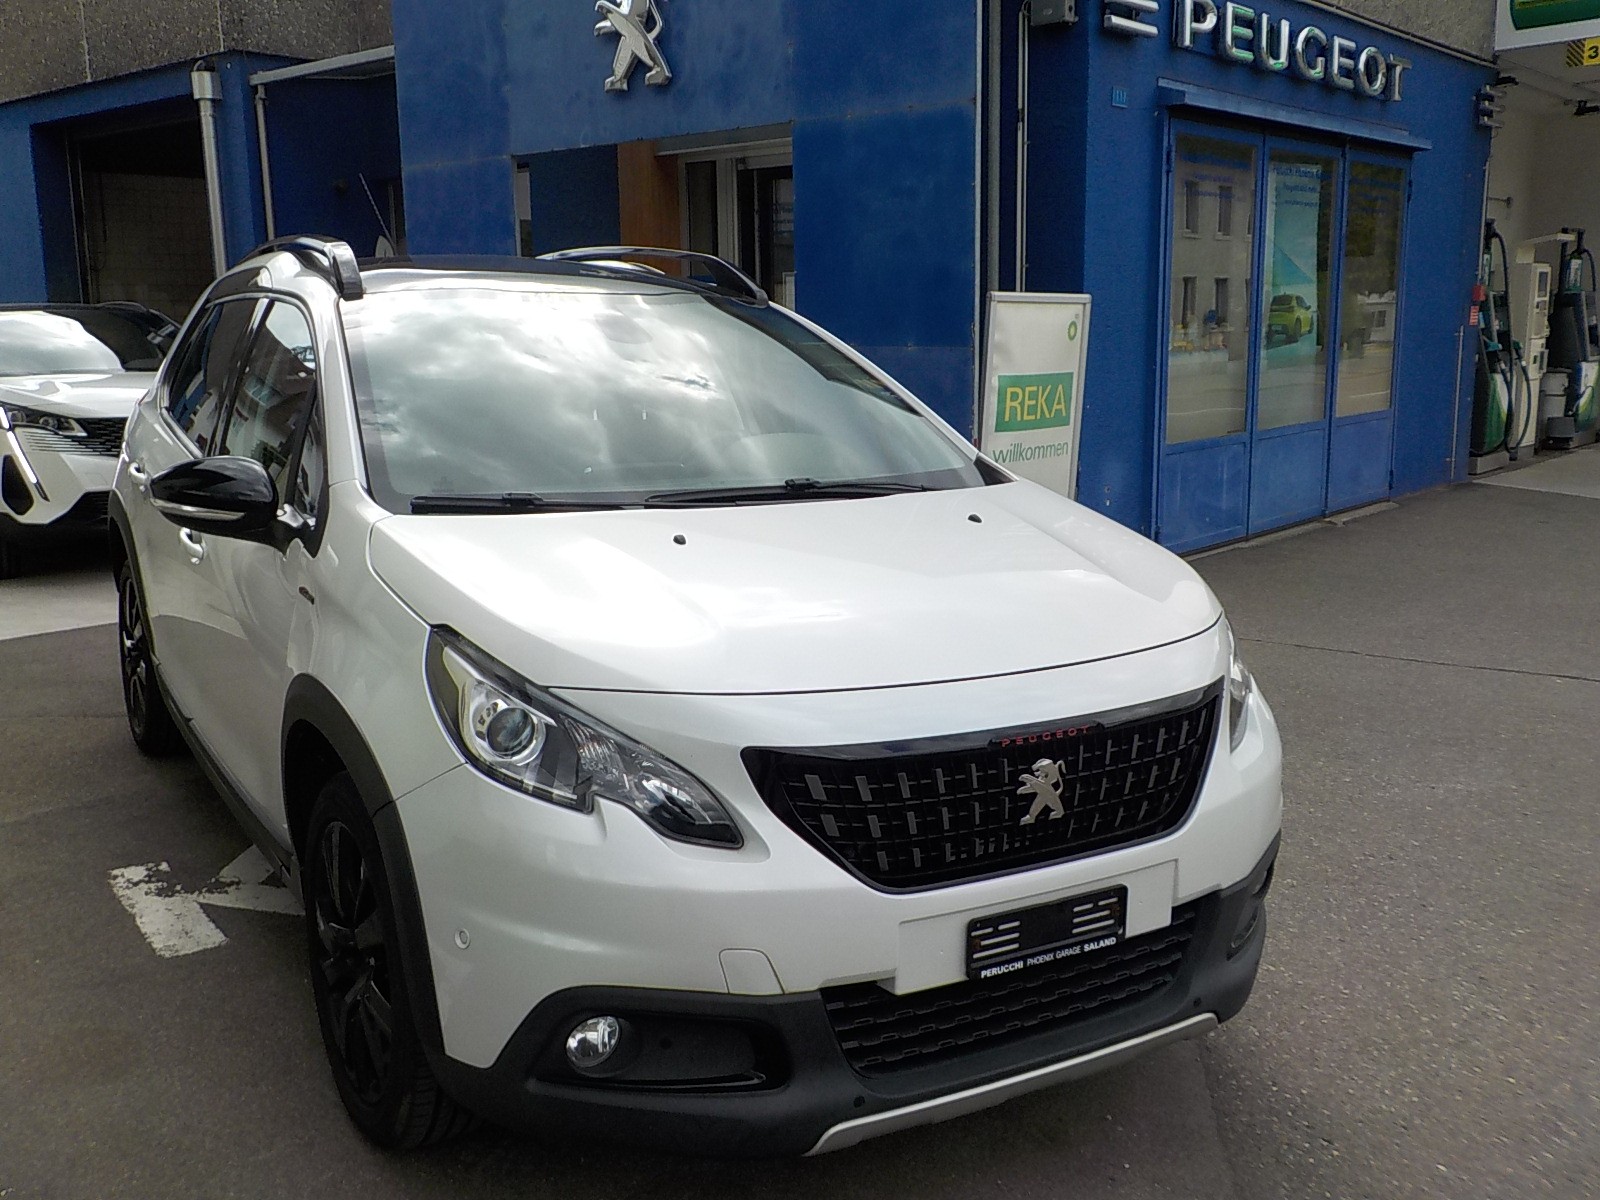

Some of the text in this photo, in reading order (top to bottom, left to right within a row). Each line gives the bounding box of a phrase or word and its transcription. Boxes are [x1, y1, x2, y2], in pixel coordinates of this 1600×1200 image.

[1172, 0, 1412, 101] PEUGEOT
[1588, 45, 1599, 59] 3
[1004, 384, 1067, 422] REKA
[992, 441, 1069, 464] willkommen
[1001, 724, 1089, 748] PEUGEOT
[980, 936, 1117, 979] PERUCCHI PHOENIX GARAGE SALAND
